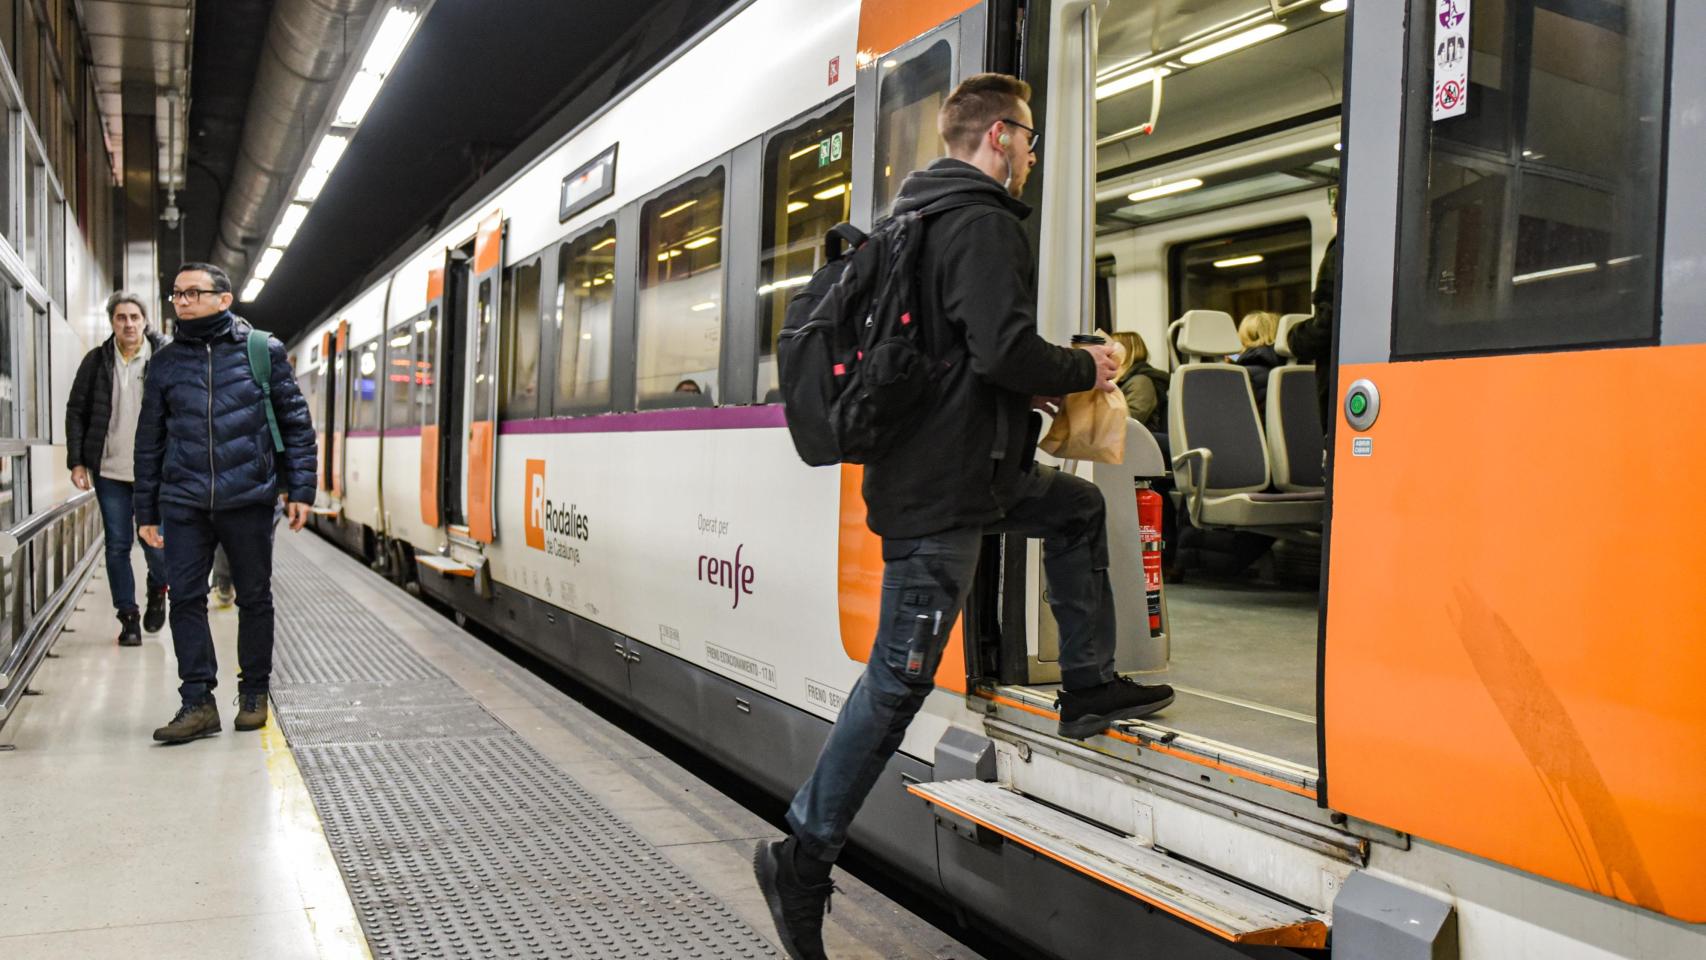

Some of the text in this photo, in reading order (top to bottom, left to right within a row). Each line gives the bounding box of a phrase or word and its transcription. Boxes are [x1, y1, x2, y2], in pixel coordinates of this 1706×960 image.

[531, 472, 545, 529] R
[545, 499, 589, 542] Rodalies
[697, 513, 729, 538] Operat per
[698, 543, 755, 610] renfe
[808, 684, 845, 708] FRENO SERV
